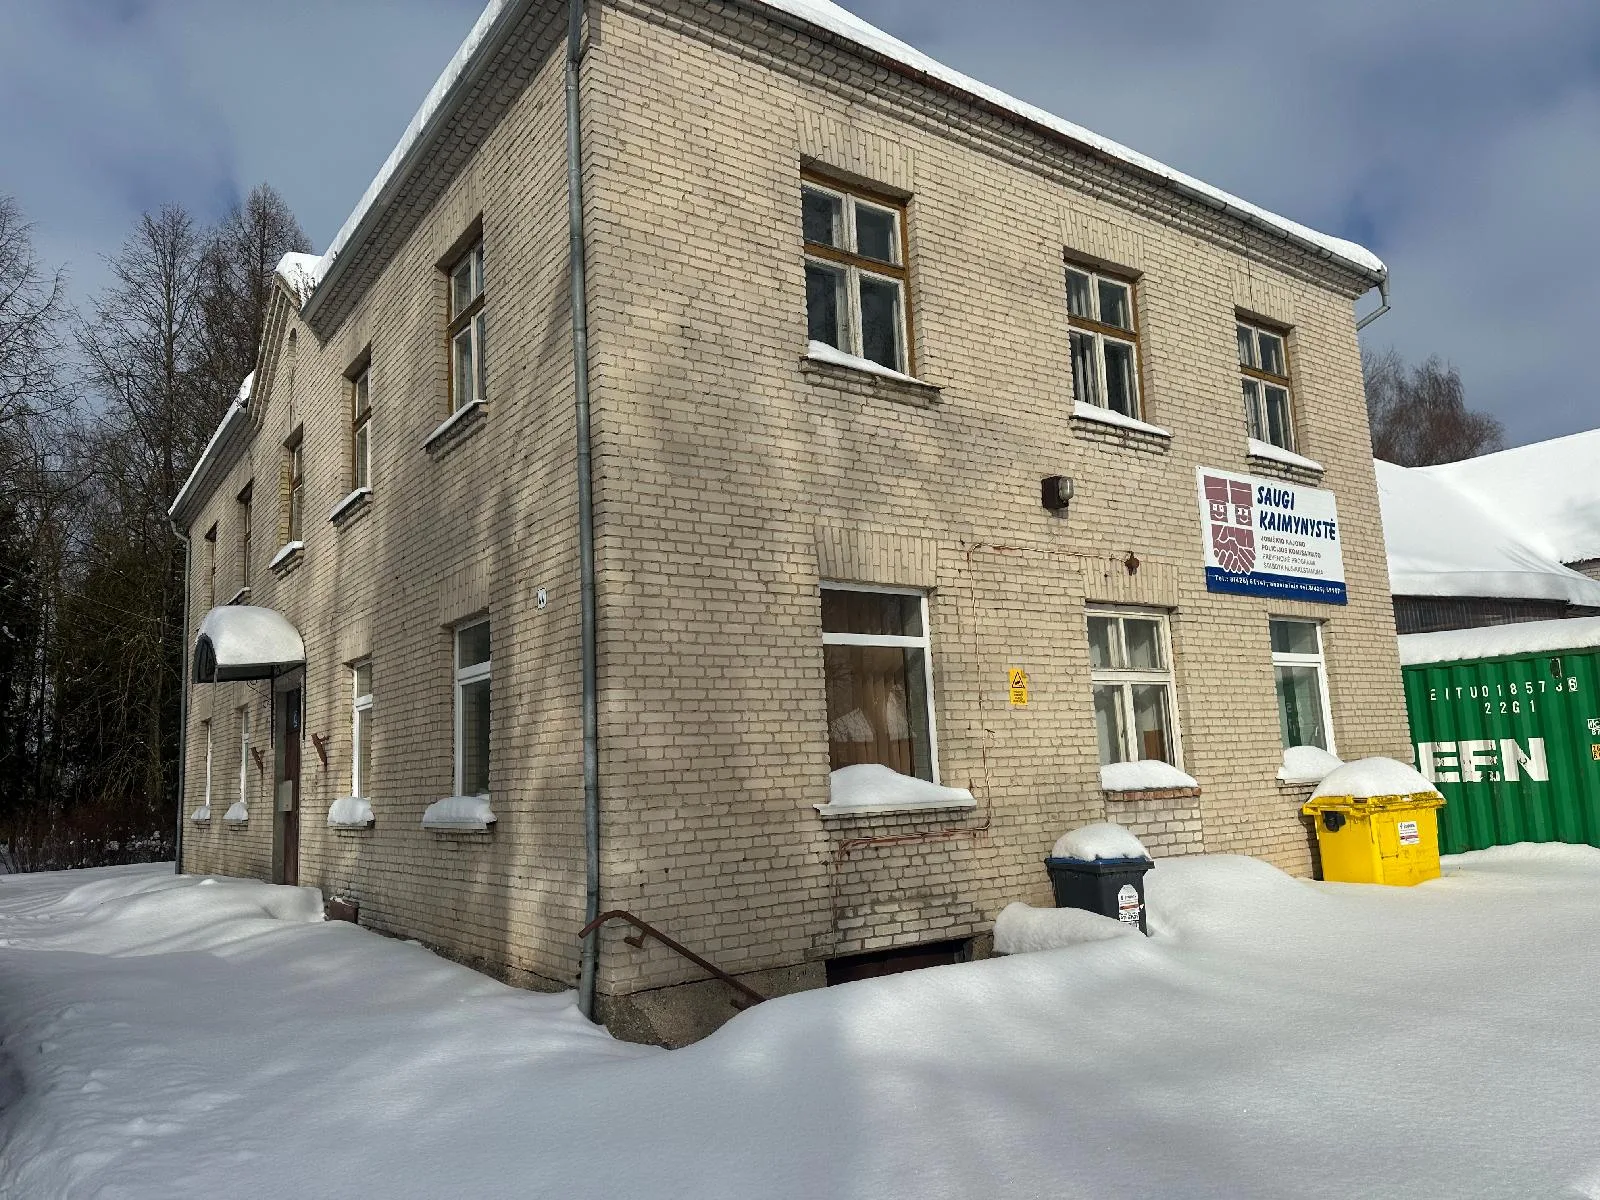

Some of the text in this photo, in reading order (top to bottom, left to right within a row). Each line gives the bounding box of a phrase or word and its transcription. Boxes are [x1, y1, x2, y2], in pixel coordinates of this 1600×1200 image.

[1257, 486, 1295, 510] SAUGI
[1260, 510, 1336, 541] KAIMYNYSTĖ
[1262, 544, 1322, 558] POLICIJOS KOMISARIATO
